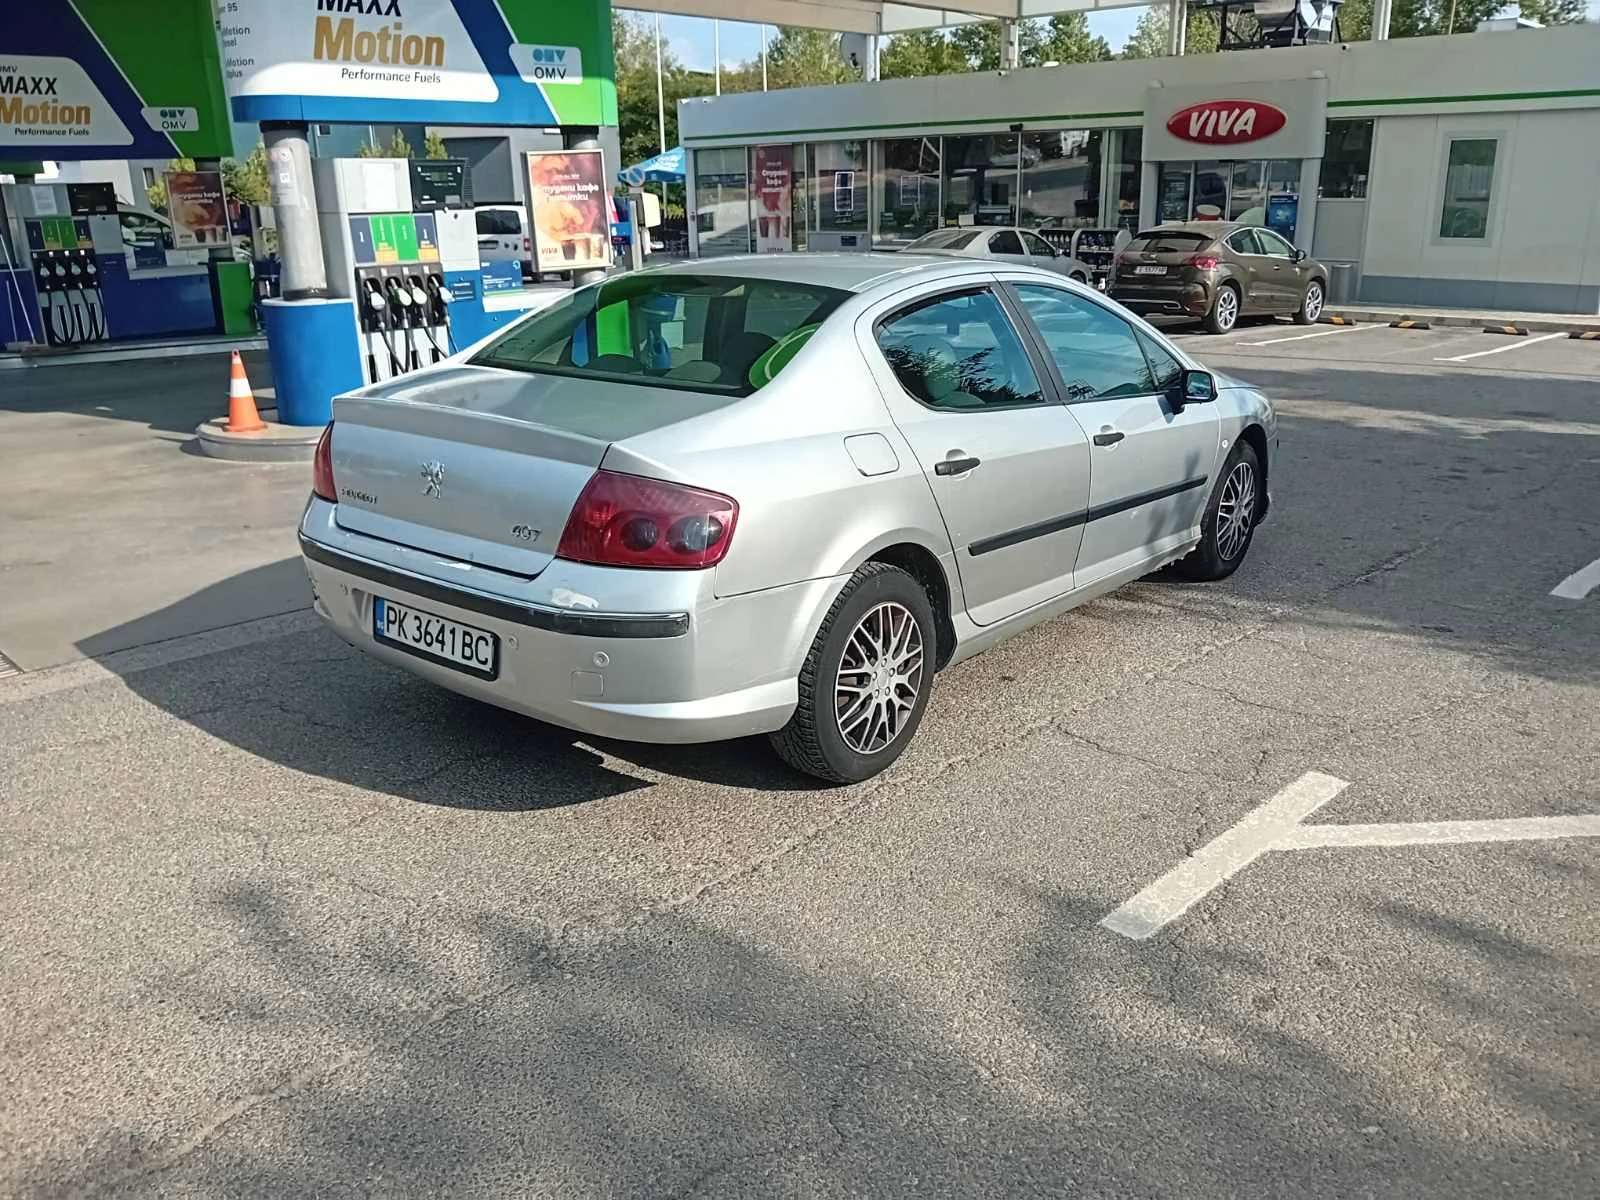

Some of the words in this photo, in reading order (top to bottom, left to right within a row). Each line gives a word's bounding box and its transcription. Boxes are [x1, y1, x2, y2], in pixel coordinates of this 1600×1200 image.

[313, 15, 444, 67] Motion
[0, 65, 18, 73] MV
[341, 67, 411, 82] Performance
[414, 71, 441, 84] Fuels
[534, 66, 567, 80] OMV
[0, 75, 58, 96] MAXX
[0, 96, 92, 126] Motion
[14, 127, 67, 137] Performance
[68, 128, 90, 137] Fuels
[161, 120, 187, 130] OMV
[1189, 107, 1257, 138] VIVA
[512, 524, 542, 543] 407
[386, 605, 408, 640] PK
[412, 615, 457, 657] 3641
[461, 630, 489, 666] BC
